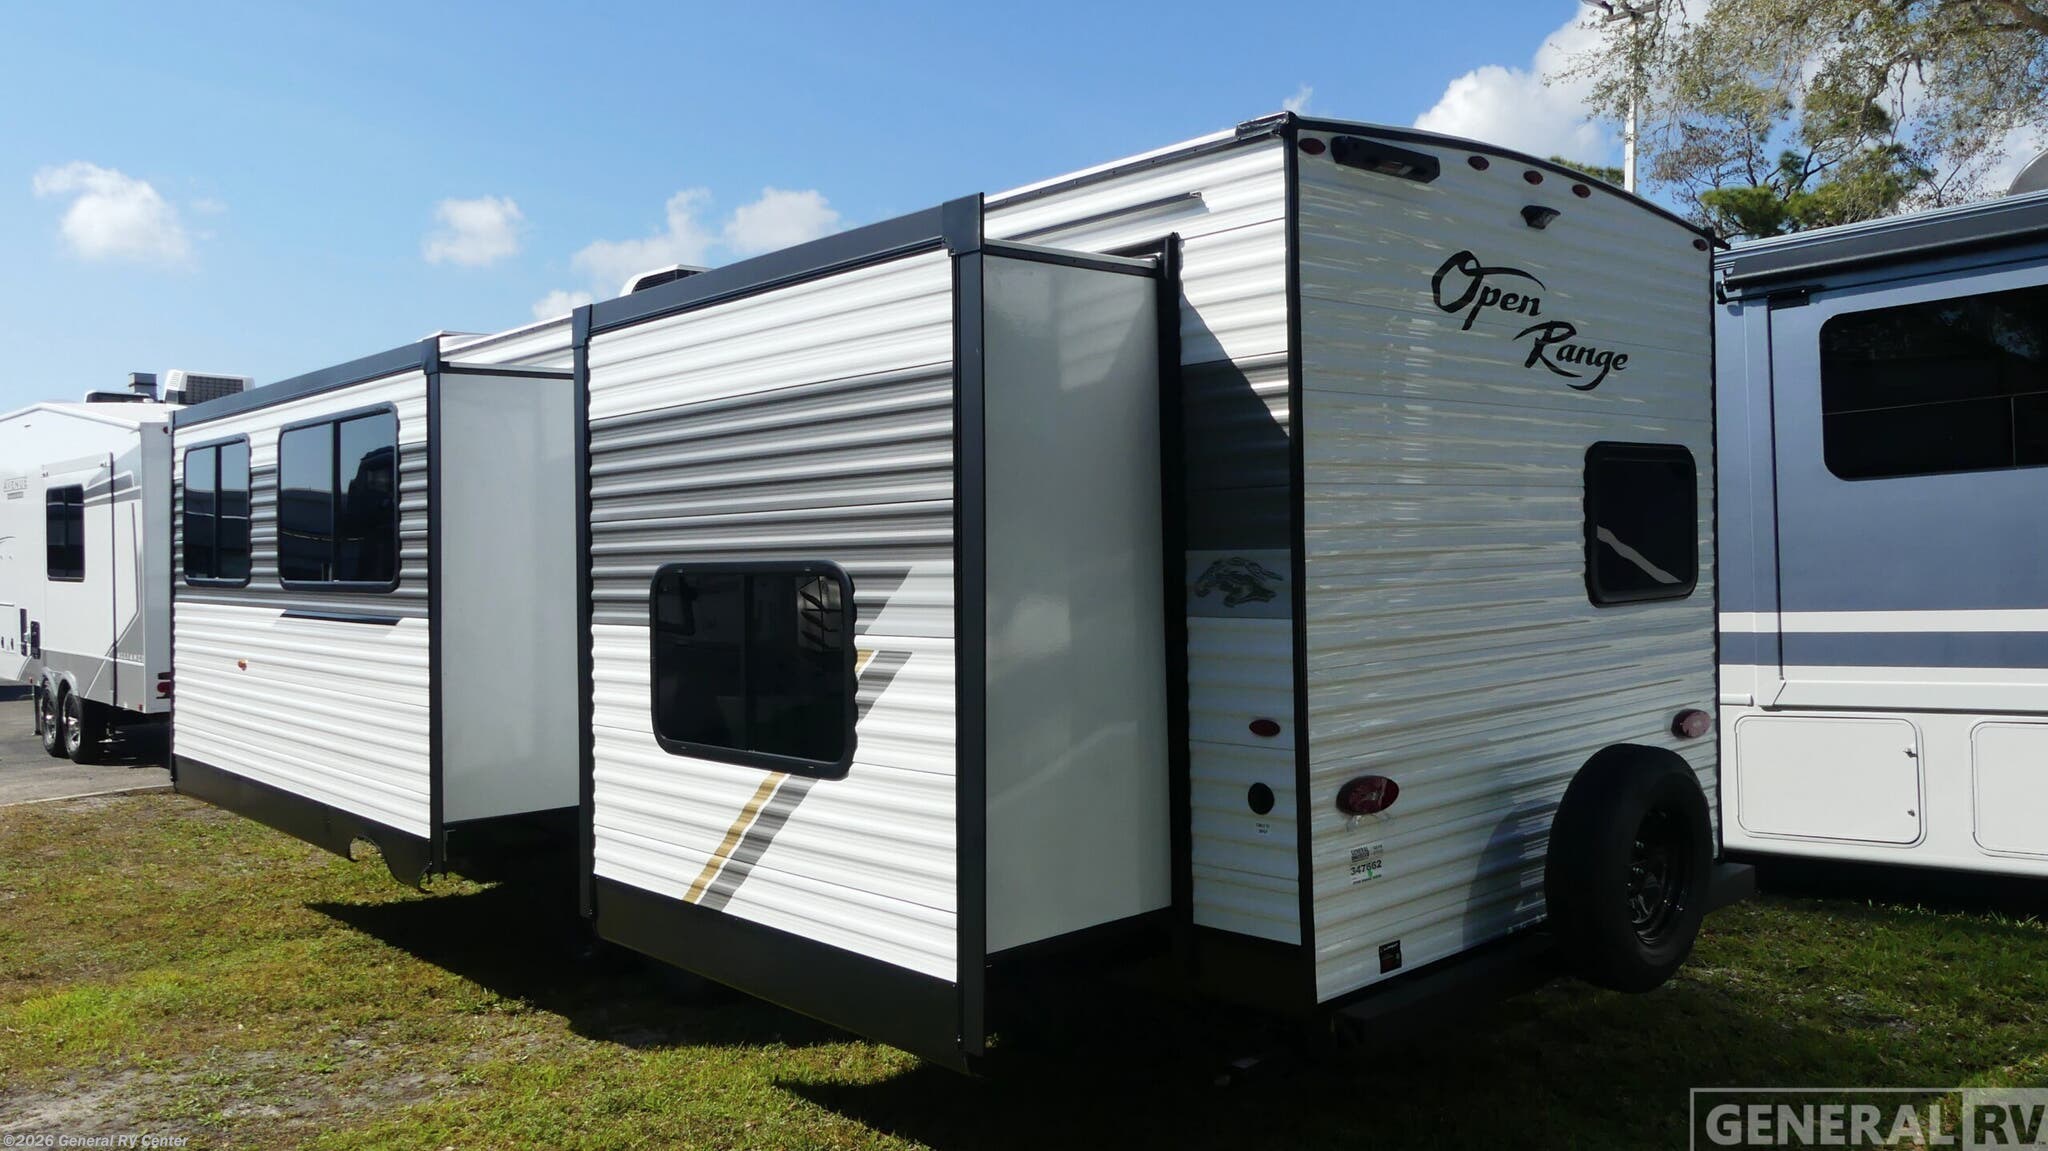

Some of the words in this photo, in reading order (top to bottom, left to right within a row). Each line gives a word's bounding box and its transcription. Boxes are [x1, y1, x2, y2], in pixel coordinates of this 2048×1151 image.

[1431, 250, 1546, 331] Open
[1513, 320, 1629, 391] Range
[1350, 860, 1382, 875] 347662
